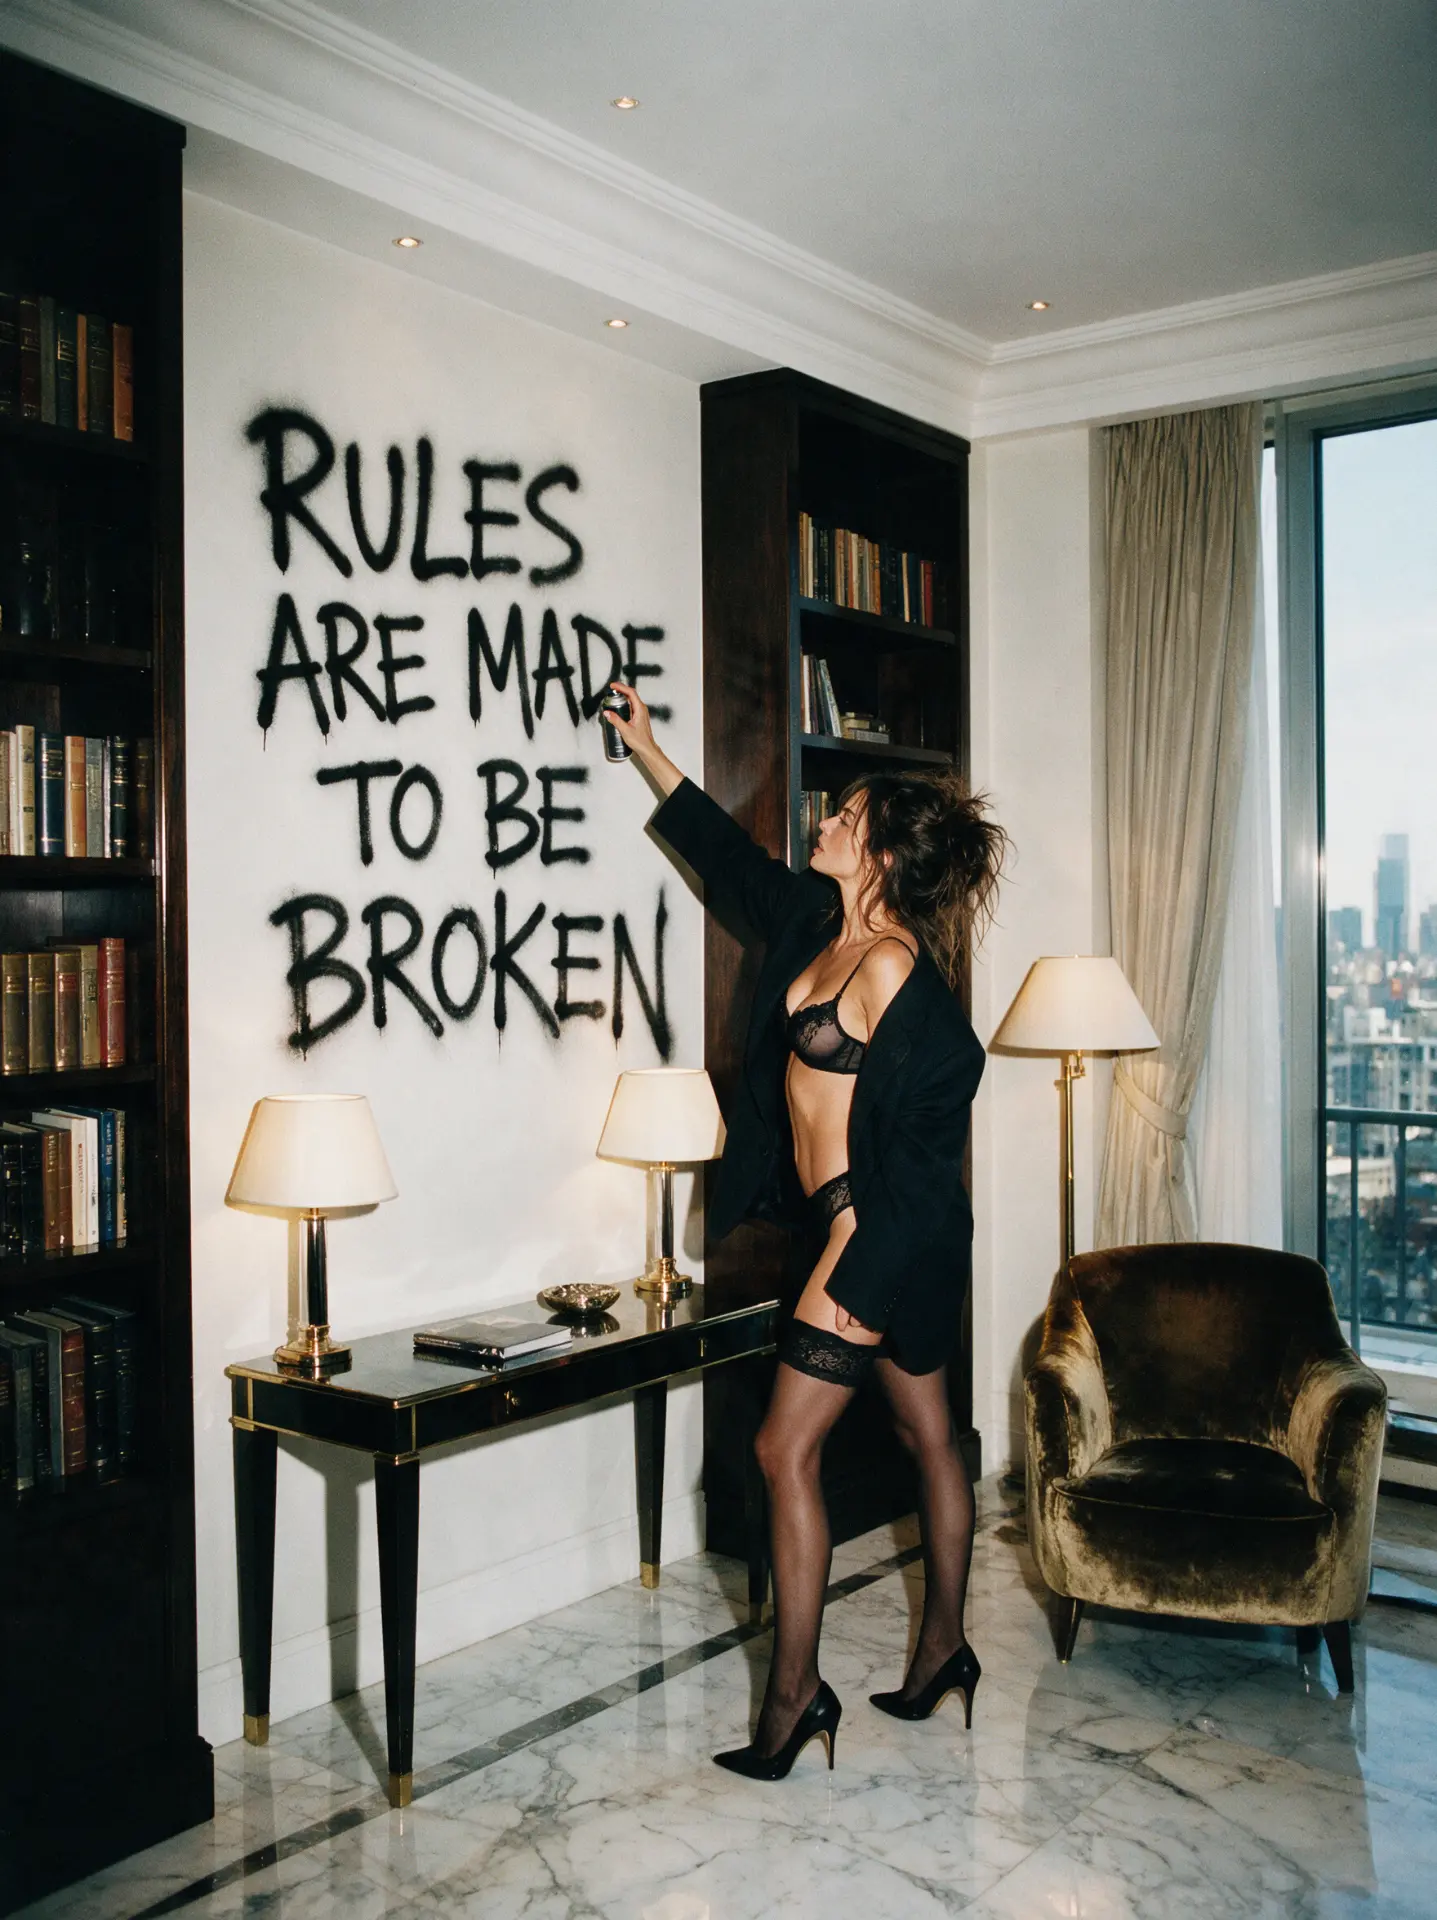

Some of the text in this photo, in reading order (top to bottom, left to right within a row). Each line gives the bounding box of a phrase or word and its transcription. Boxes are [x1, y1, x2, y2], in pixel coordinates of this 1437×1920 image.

[242, 403, 584, 588] RULES
[255, 592, 673, 744] ARE MADE
[315, 758, 591, 879] TO BE
[268, 887, 674, 1064] BROKEN
